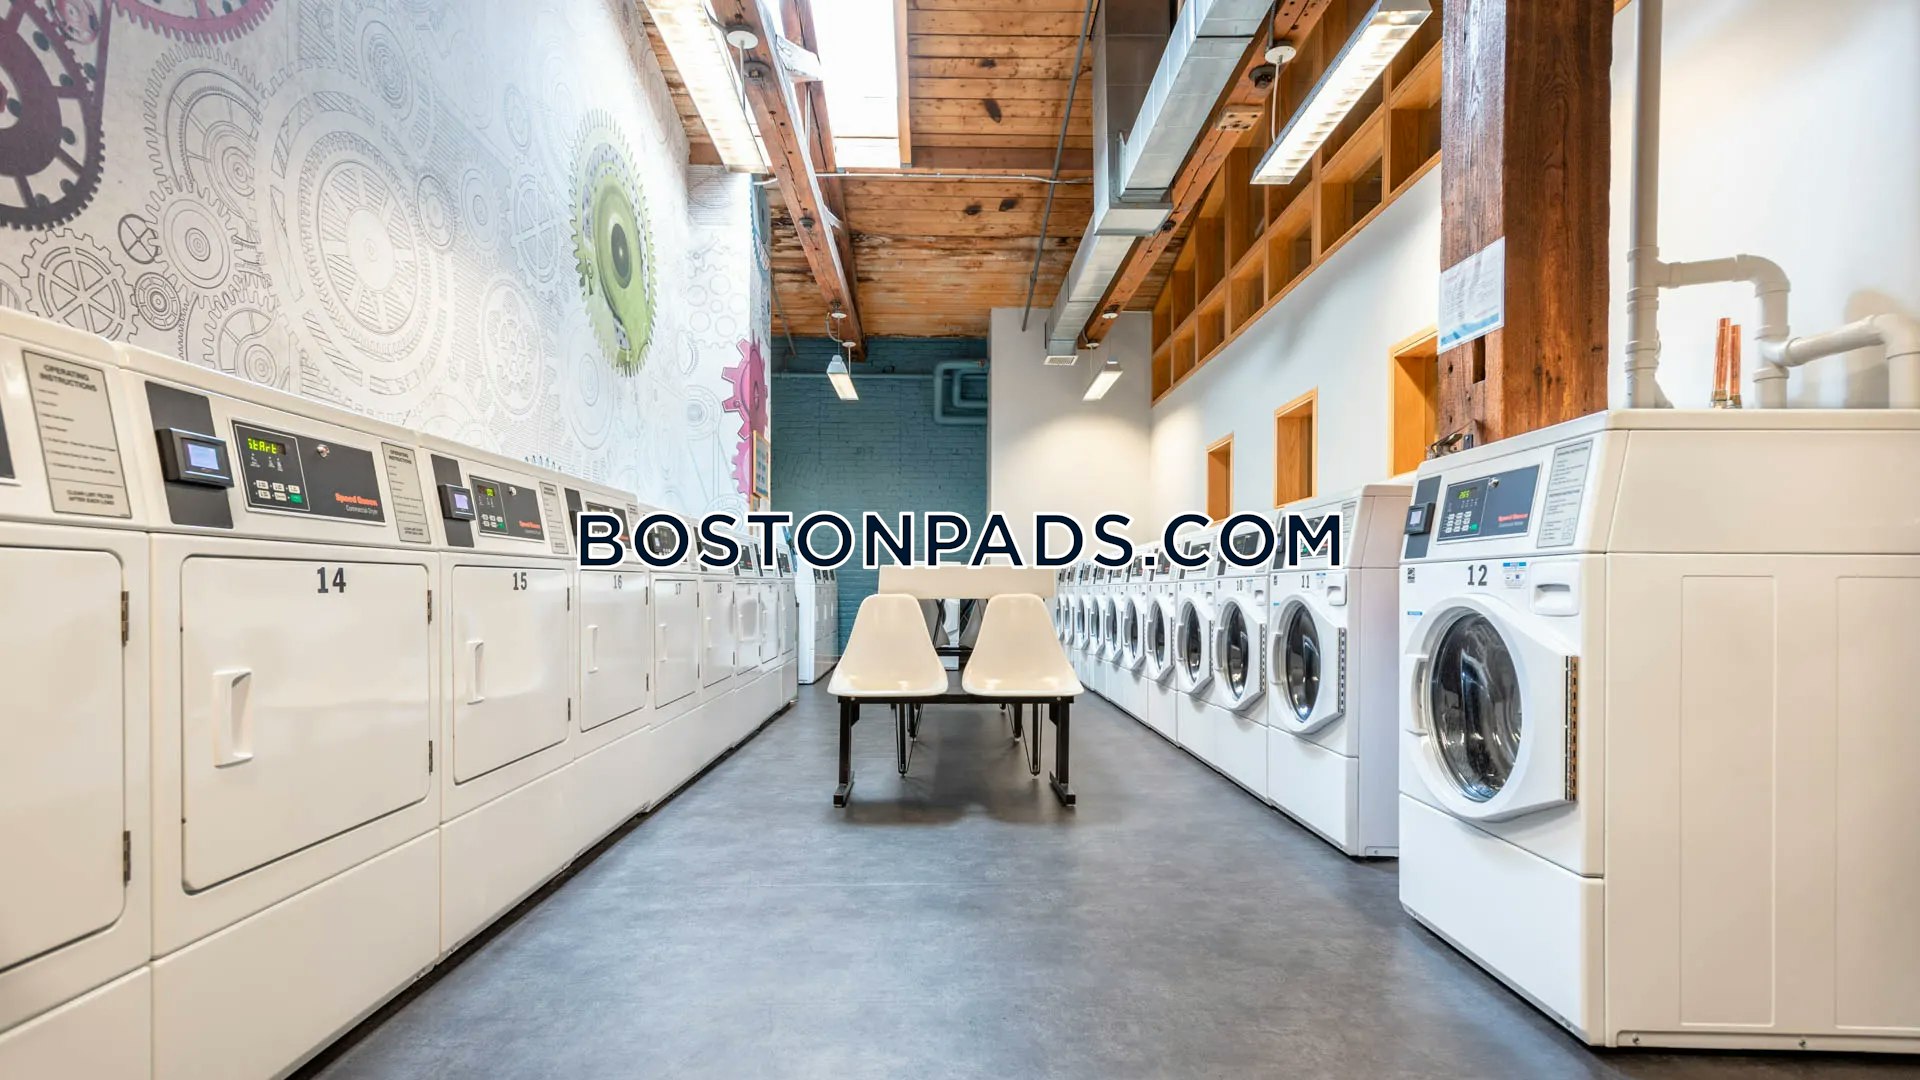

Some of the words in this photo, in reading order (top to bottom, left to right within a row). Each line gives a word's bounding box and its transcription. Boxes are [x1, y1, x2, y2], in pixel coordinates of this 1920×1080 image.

[43, 364, 90, 381] OPERATING
[39, 373, 97, 392] INSTRUCTIONS
[317, 566, 346, 593] 14
[512, 572, 527, 590] 15
[613, 574, 623, 589] 16
[1301, 575, 1310, 589] 11
[1467, 564, 1488, 586] 12
[675, 583, 682, 595] 17
